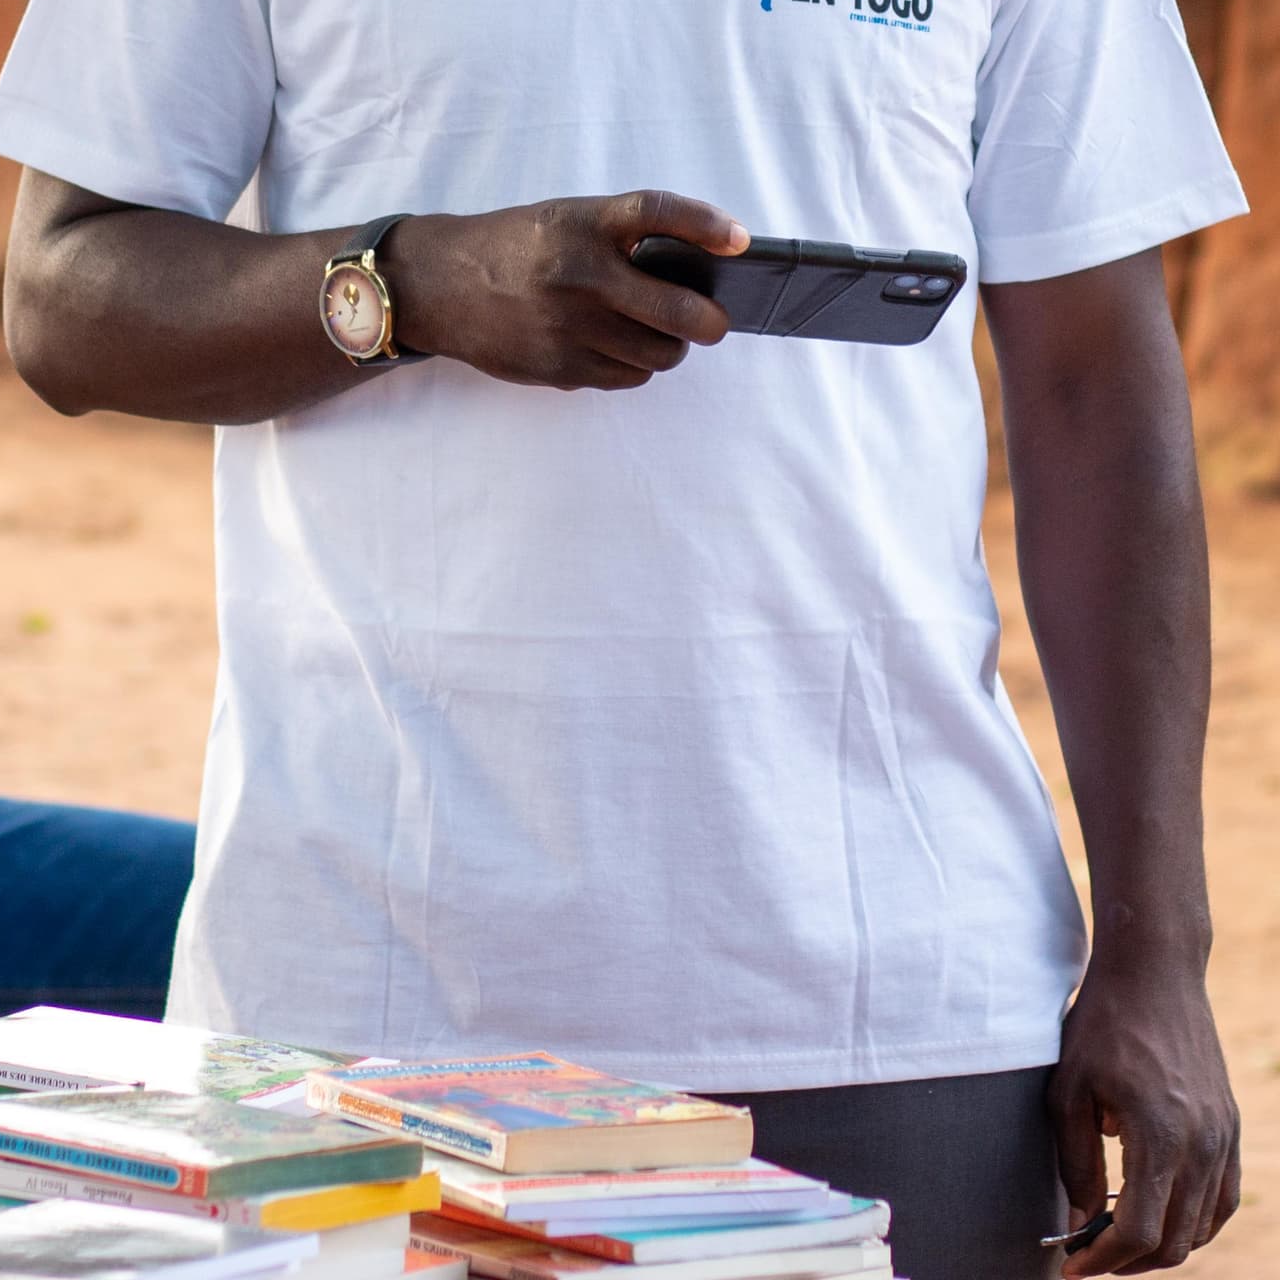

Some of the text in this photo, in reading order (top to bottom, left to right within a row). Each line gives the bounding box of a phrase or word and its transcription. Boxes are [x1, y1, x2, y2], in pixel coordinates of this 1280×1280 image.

[9, 1071, 26, 1082] DES
[28, 1075, 66, 1088] GUERRE
[66, 1080, 80, 1090] LA
[21, 1140, 51, 1160] DIEUX
[55, 1149, 73, 1165] LES
[85, 1154, 123, 1174] FRANCE
[127, 1161, 170, 1182] ANATOLE
[25, 1177, 134, 1205] Pirandello Henri IV
